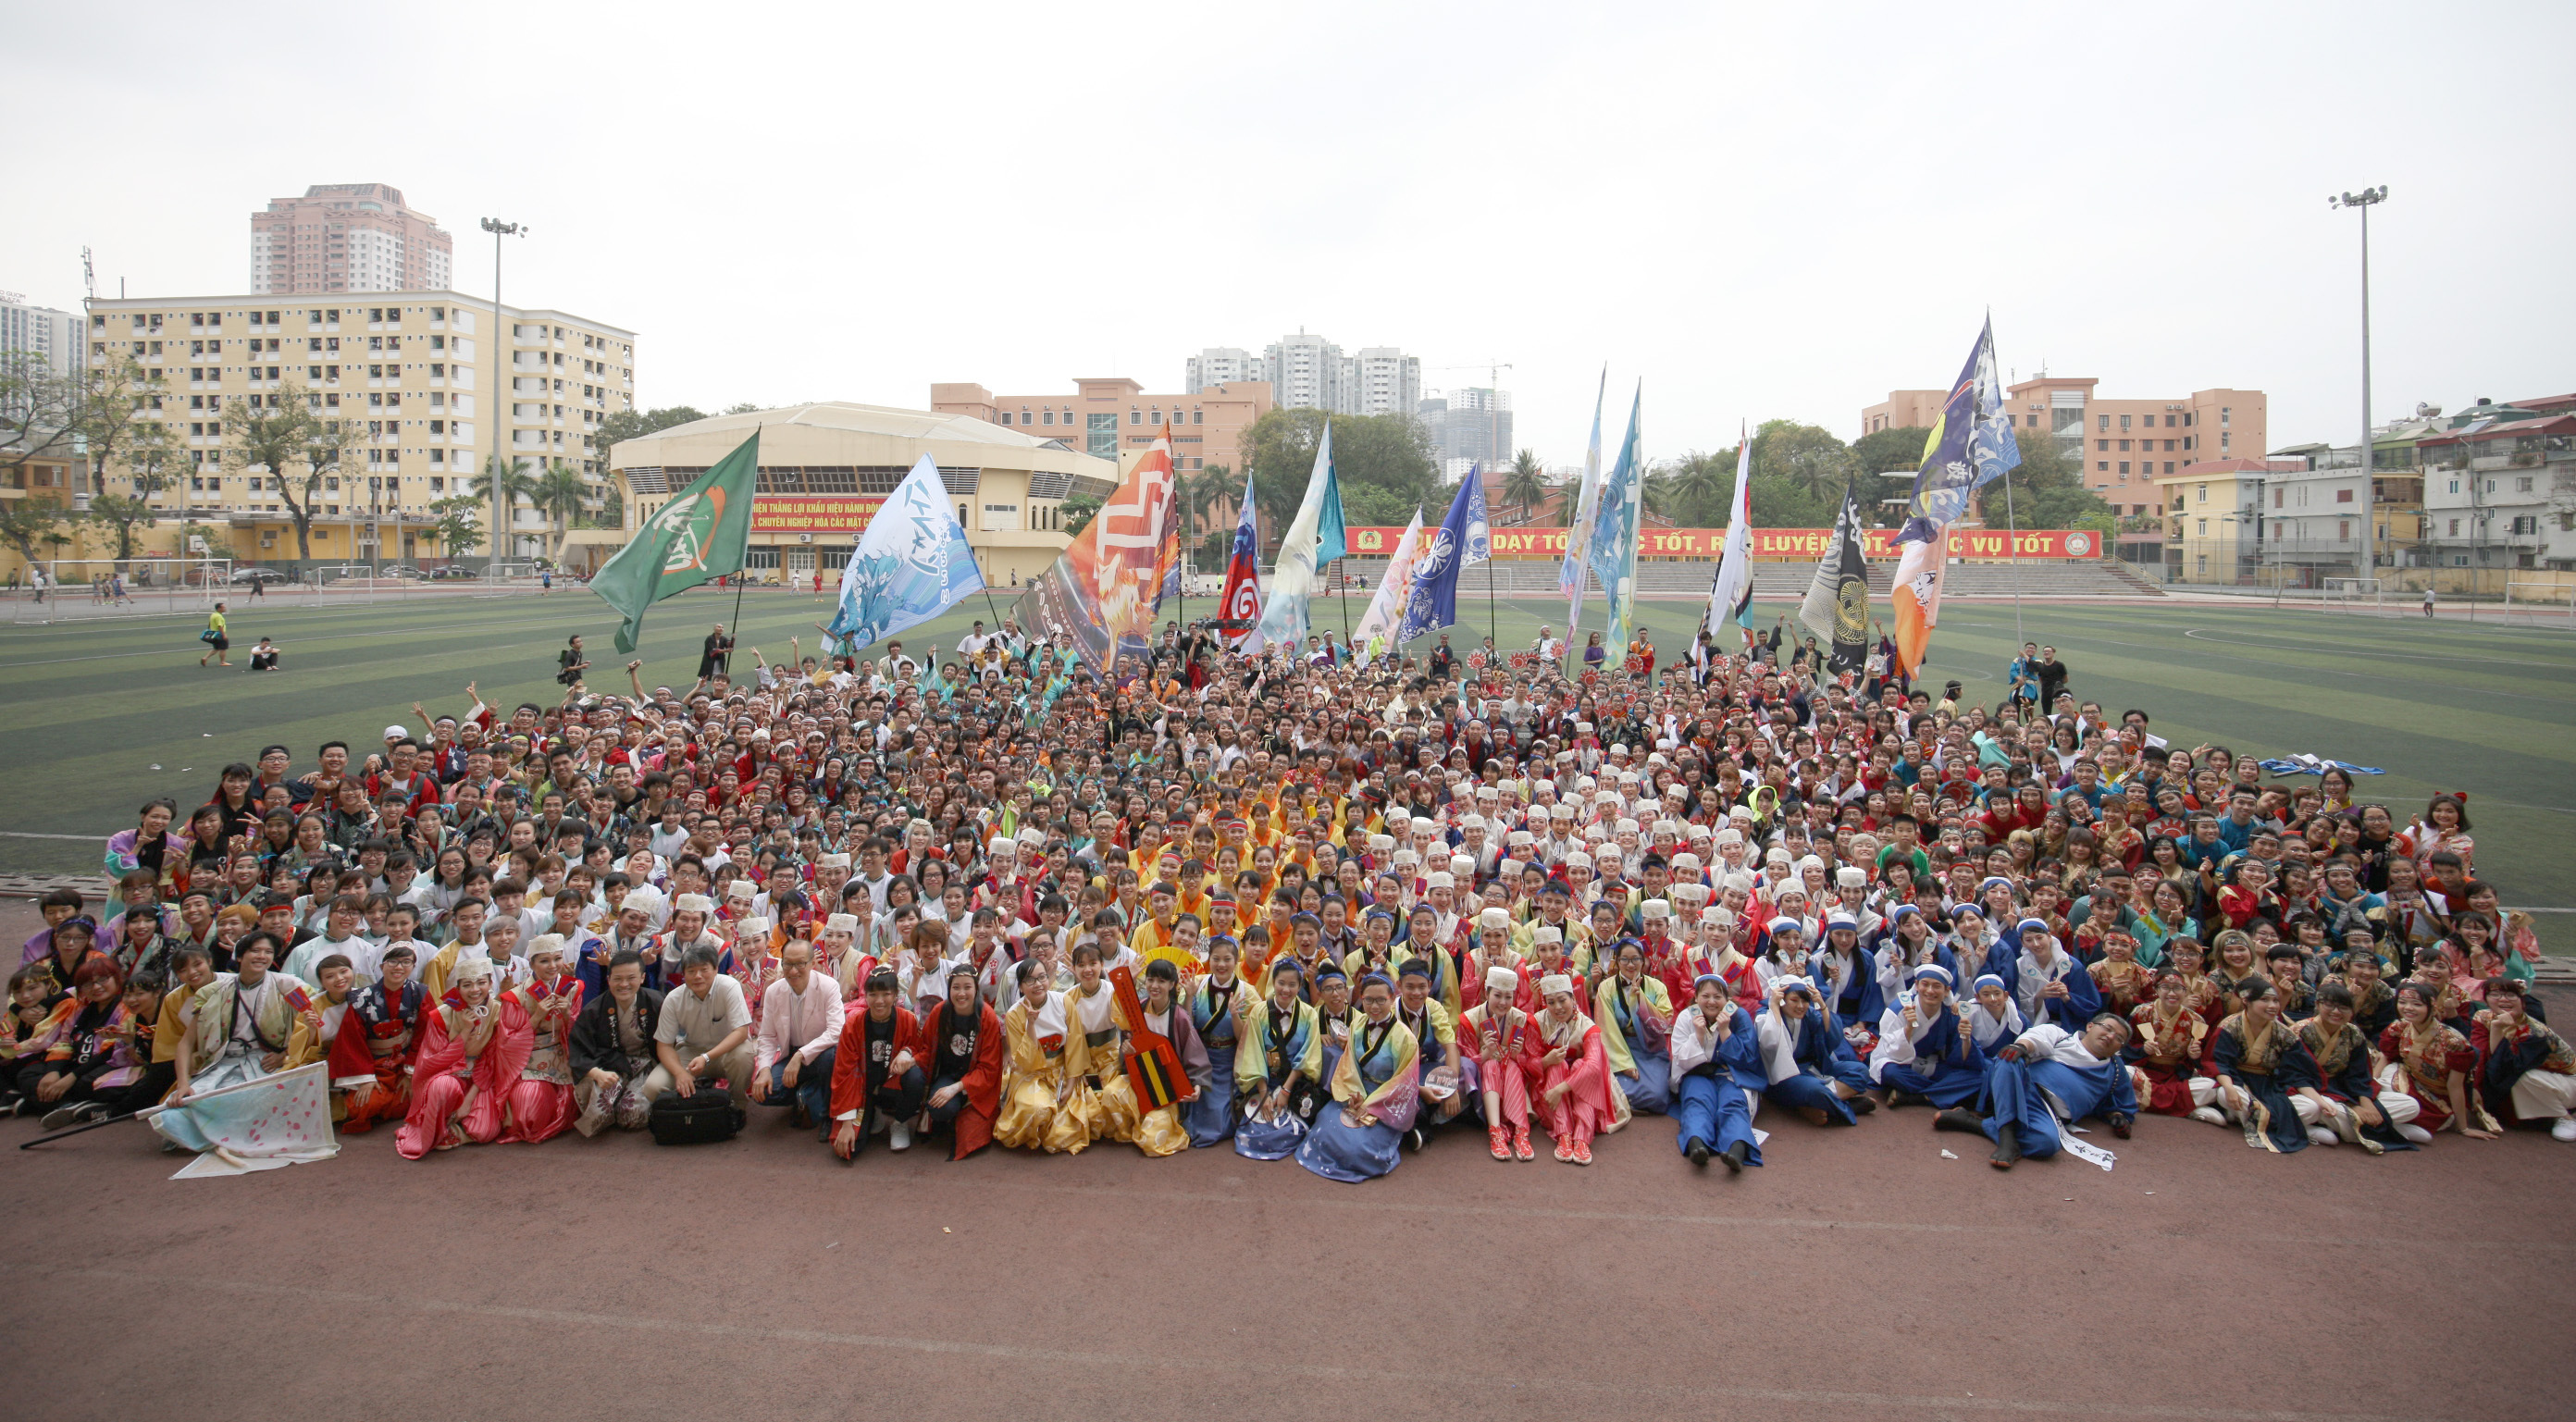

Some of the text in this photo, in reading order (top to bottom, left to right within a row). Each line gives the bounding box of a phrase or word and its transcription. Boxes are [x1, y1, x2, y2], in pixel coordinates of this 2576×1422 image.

[769, 501, 792, 513] THẮNG
[794, 502, 804, 515] LỢI
[806, 500, 825, 513] KHẨU
[827, 501, 843, 515] HIỆU
[845, 501, 864, 513] HÀNH
[866, 501, 883, 515] ĐỘN
[758, 515, 785, 527] CHUYÊN
[787, 515, 812, 529] NGHIỆP
[814, 515, 829, 527] HÓA
[831, 515, 845, 527] CÁC
[847, 515, 861, 529] MẶT
[1492, 534, 1536, 553] DẠY
[1542, 531, 1568, 550] TỐ
[1653, 530, 1702, 553] TỐT,
[1764, 533, 1831, 555] LUYỆN
[1972, 537, 2002, 555] VỤ
[2011, 532, 2053, 553] TỐT
